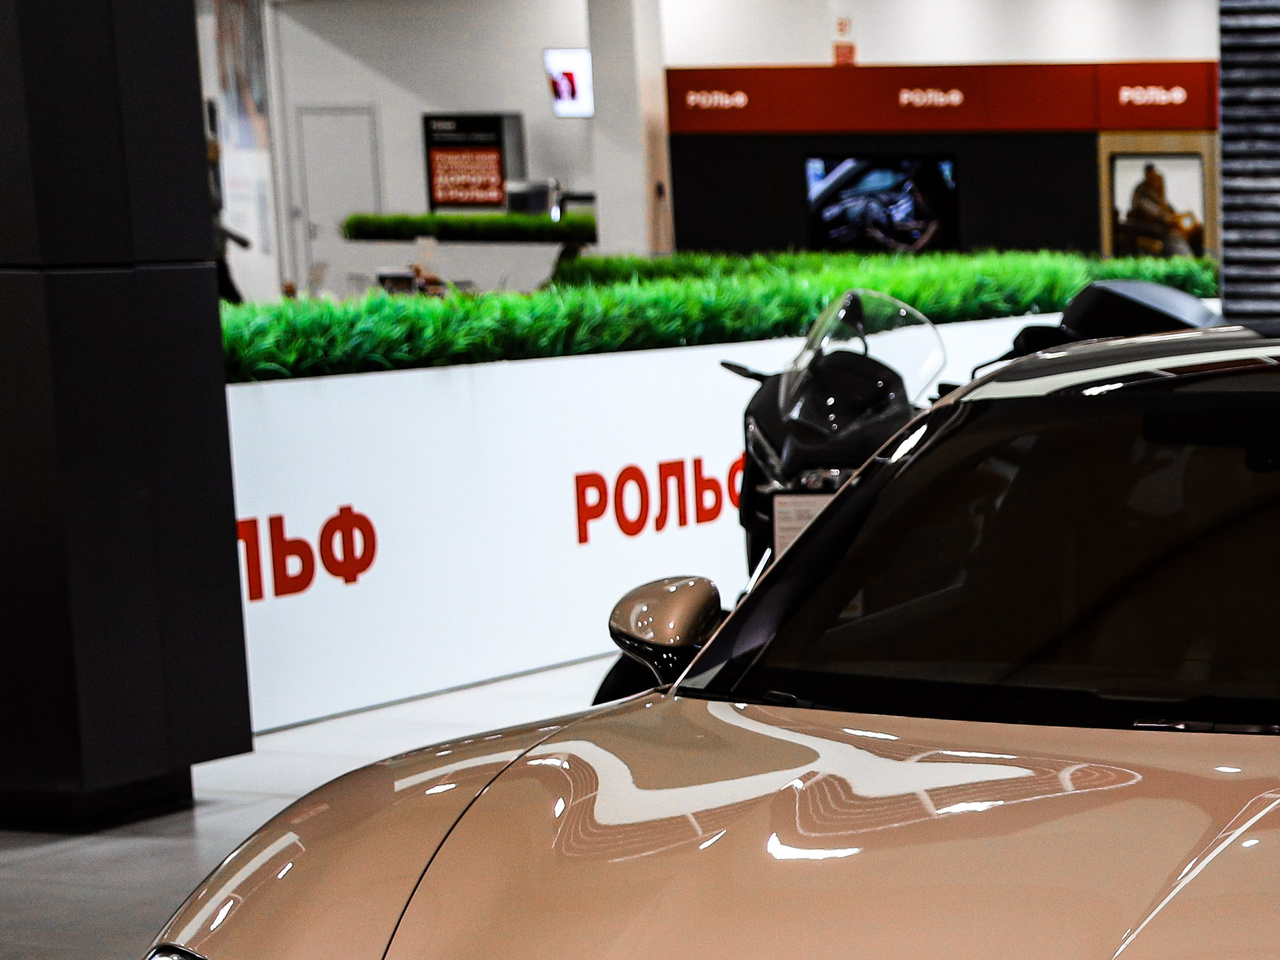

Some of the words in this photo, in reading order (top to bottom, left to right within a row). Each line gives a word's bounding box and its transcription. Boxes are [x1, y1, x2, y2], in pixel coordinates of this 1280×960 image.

[686, 90, 748, 109] РОЛЬФ
[900, 88, 964, 107] РОЛЬФ
[1119, 85, 1188, 106] РОЛЬФ
